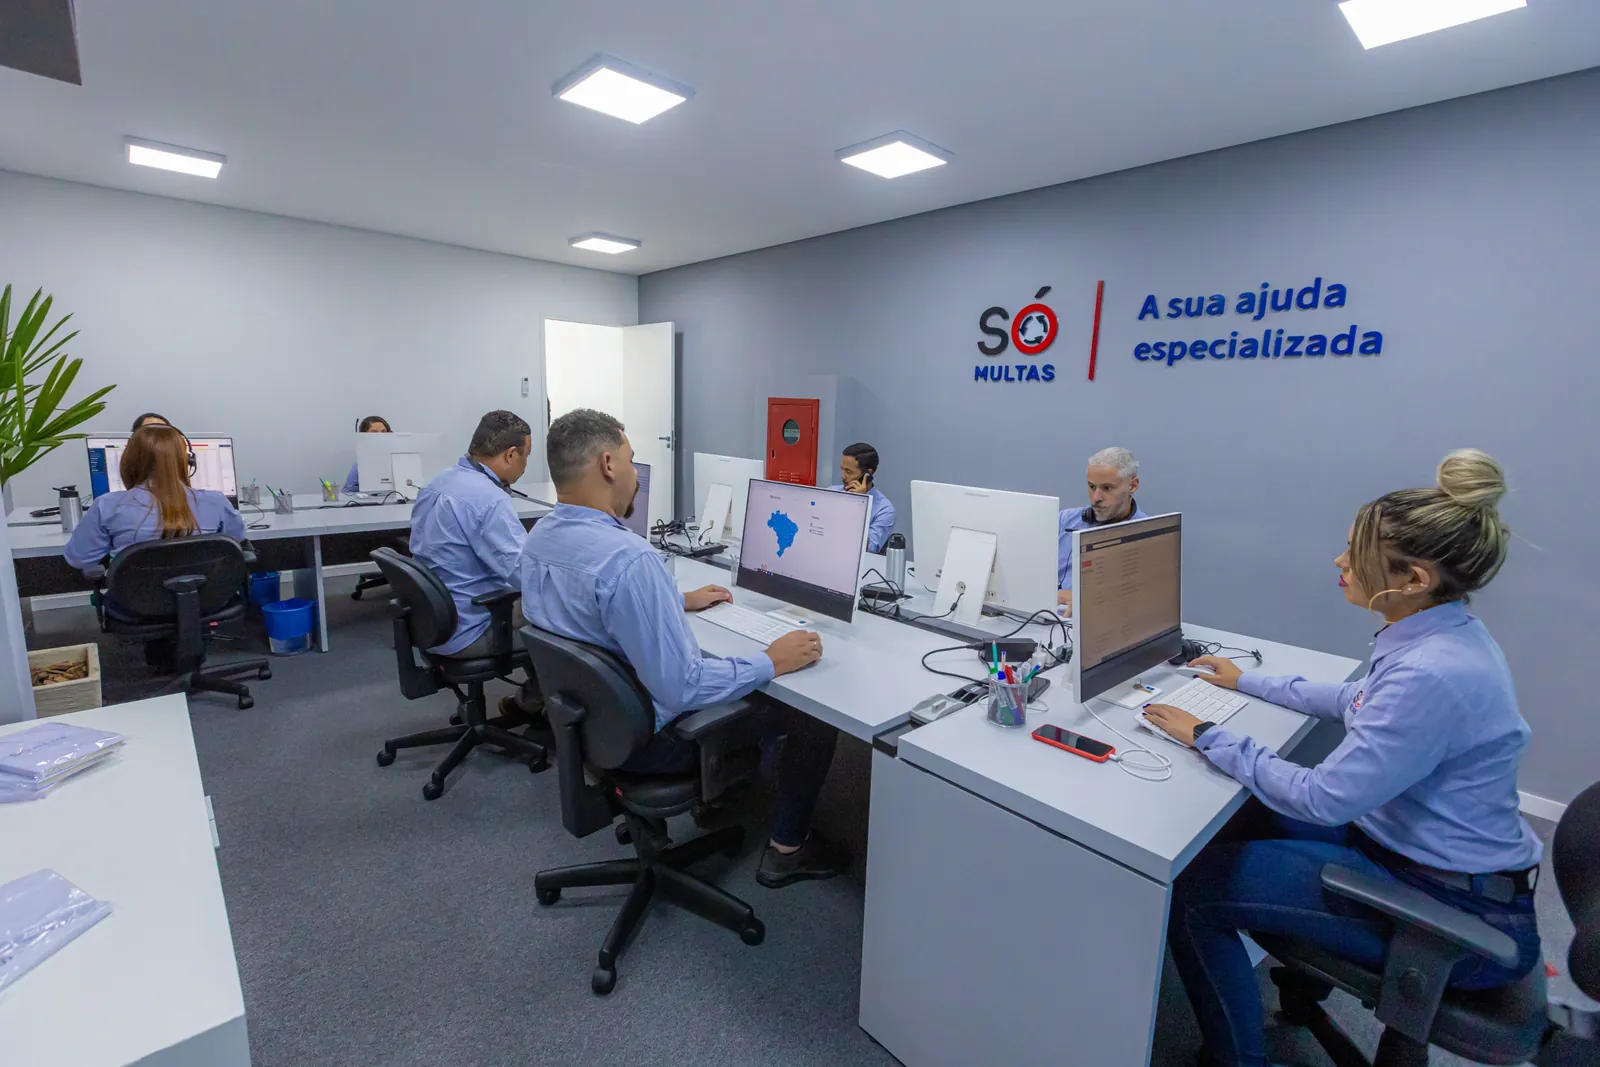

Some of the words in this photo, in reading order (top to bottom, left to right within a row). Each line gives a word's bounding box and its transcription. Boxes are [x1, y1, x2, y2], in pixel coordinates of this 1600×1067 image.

[1138, 294, 1160, 321] A
[1166, 294, 1226, 319] sua
[1235, 276, 1347, 321] ajuda
[977, 286, 1059, 356] SÓ
[1133, 324, 1383, 367] especializada
[974, 364, 1056, 382] MULTAS
